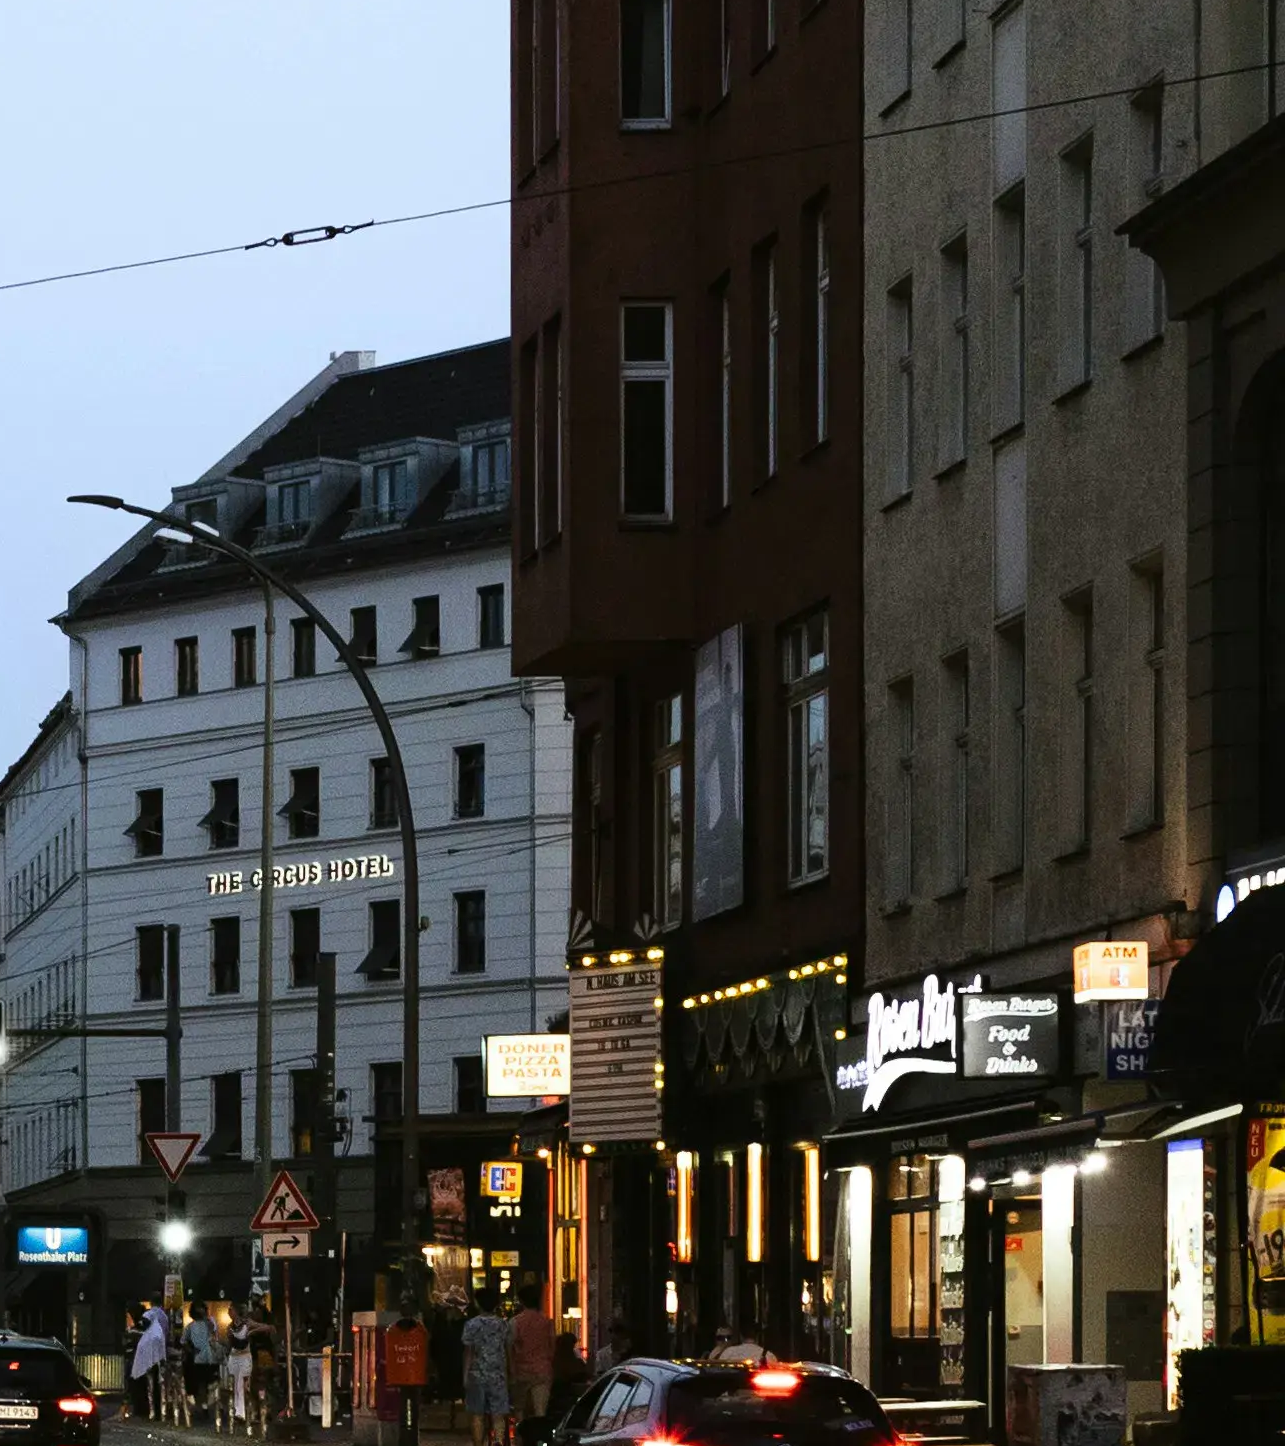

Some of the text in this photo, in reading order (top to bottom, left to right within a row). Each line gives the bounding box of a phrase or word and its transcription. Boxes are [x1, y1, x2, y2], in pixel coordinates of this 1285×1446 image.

[205, 853, 394, 895] THE CRCUS HOTEL
[1101, 946, 1138, 958] ATM
[1119, 1009, 1158, 1028] LAT
[988, 1024, 1031, 1042] Food
[1111, 1031, 1155, 1049] NIG
[498, 1041, 565, 1054] DÖNER
[505, 1055, 559, 1066] PIZZA
[985, 1055, 1038, 1074] Drinks
[1115, 1054, 1148, 1071] SH
[502, 1068, 562, 1079] PASTA
[1250, 1122, 1260, 1158] NEU
[45, 1227, 62, 1250] U
[18, 1250, 87, 1262] Rosenthaler Platz
